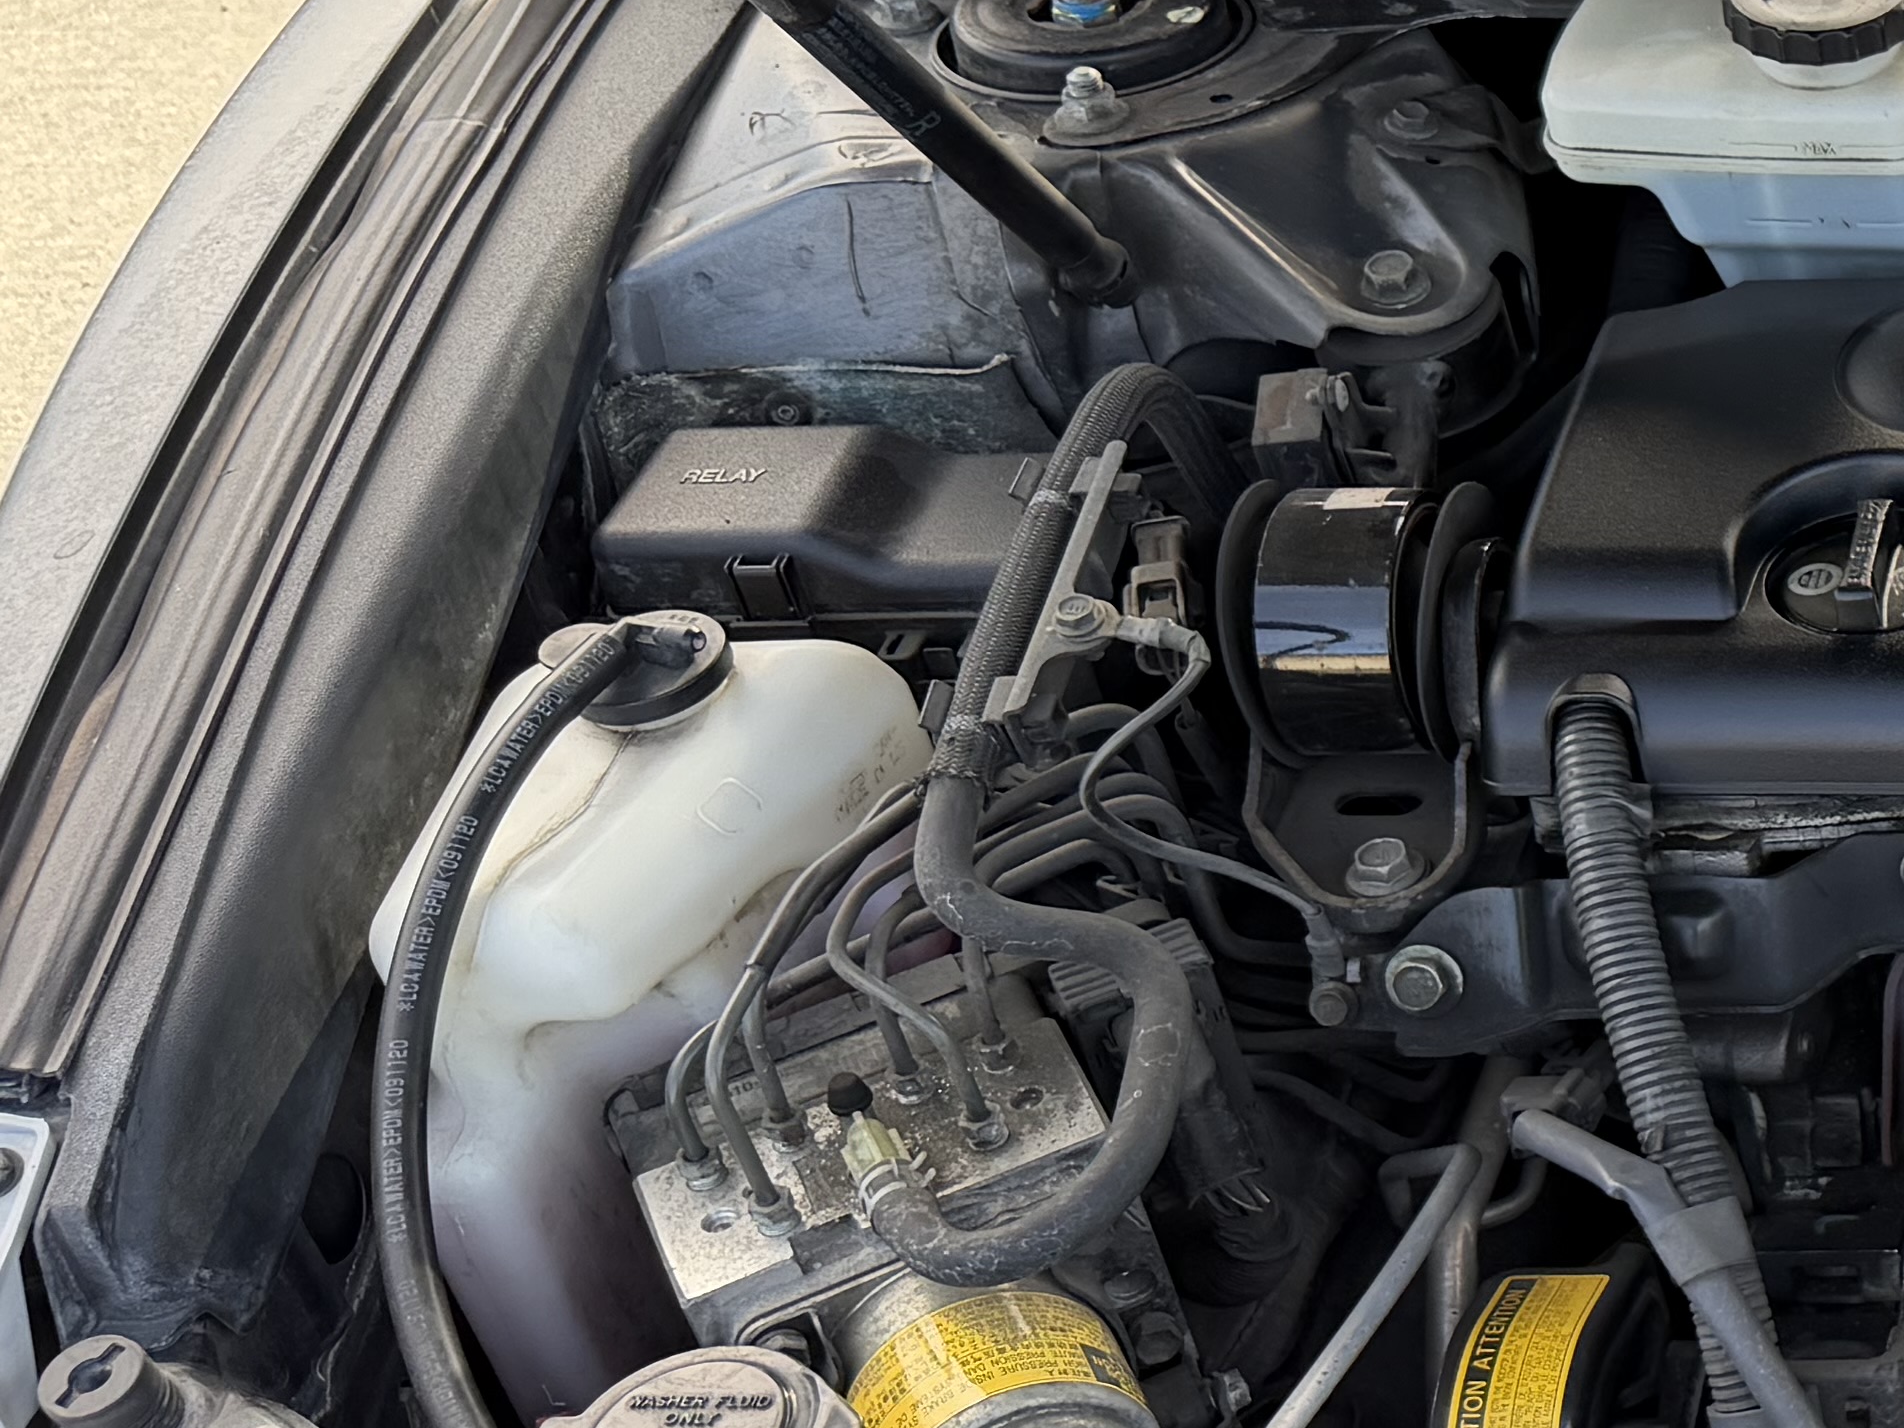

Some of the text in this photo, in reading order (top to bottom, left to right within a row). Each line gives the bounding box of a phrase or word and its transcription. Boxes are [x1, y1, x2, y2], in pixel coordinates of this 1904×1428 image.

[678, 467, 767, 486] RELAY
[1472, 1287, 1528, 1371] ATTENTION
[628, 1393, 773, 1412] WASHER FLUID
[663, 1412, 722, 1428] ONLY
